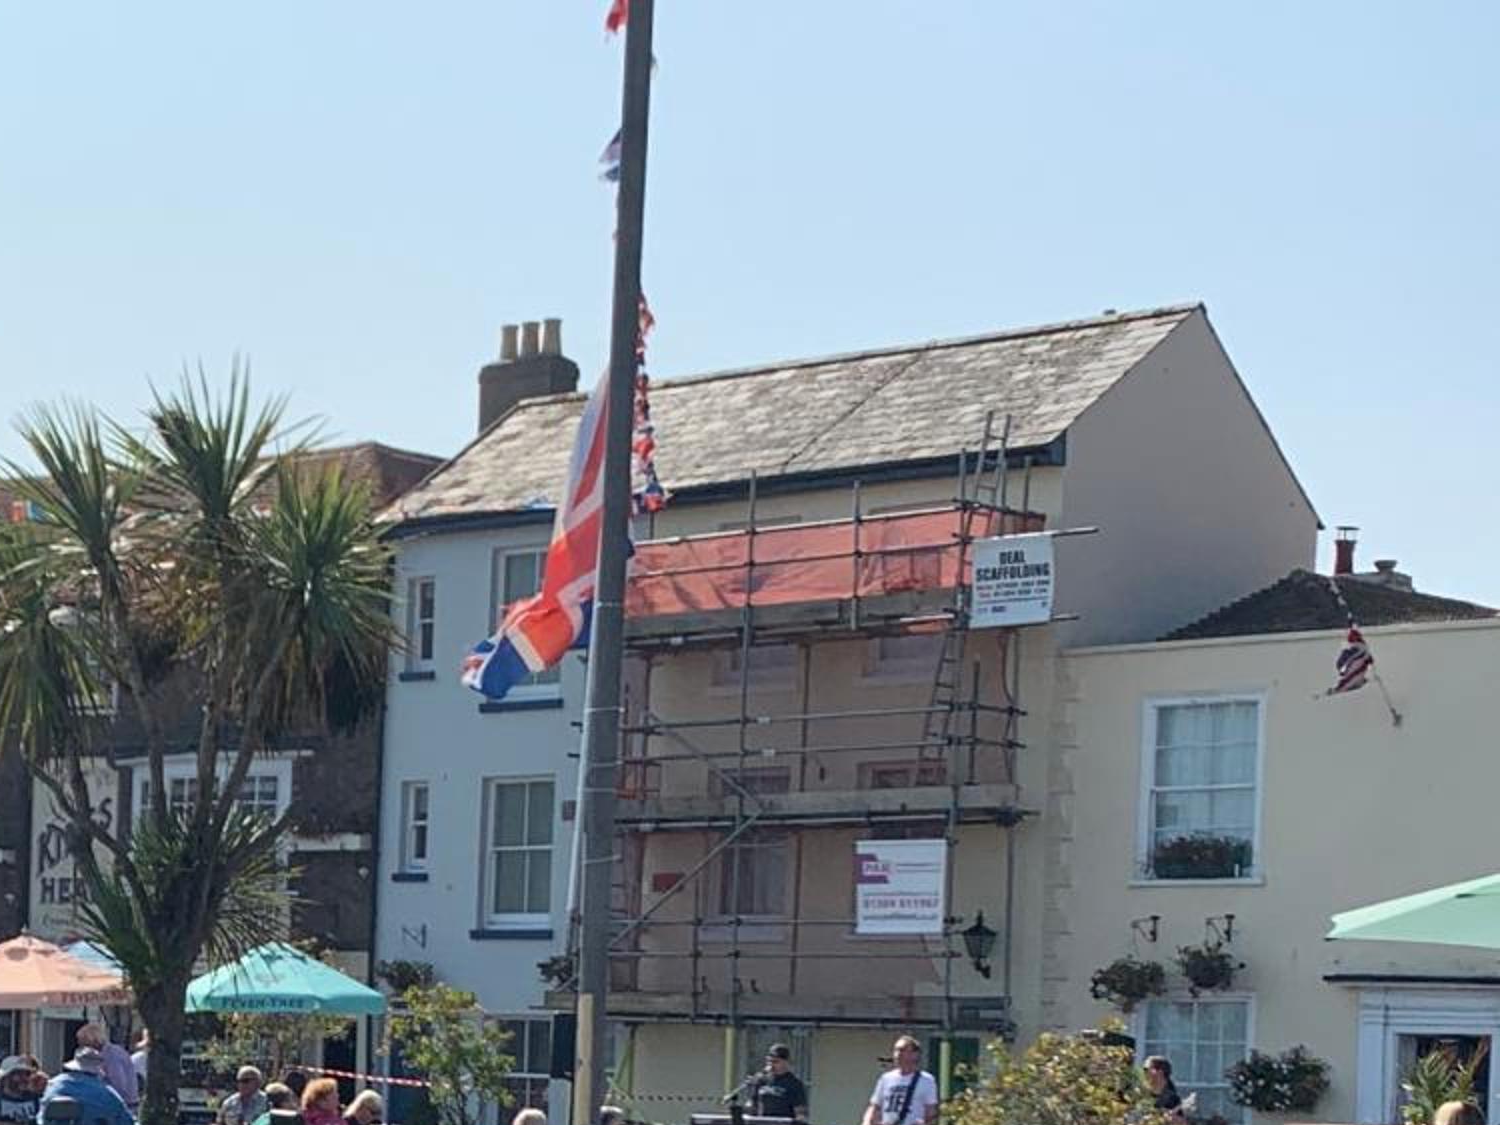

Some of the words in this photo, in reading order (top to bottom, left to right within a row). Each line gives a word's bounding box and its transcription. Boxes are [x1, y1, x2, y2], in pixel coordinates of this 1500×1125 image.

[999, 549, 1026, 564] DEAL
[976, 563, 1050, 582] SCAFFOLDING
[222, 996, 304, 1010] FEVER-TREE
